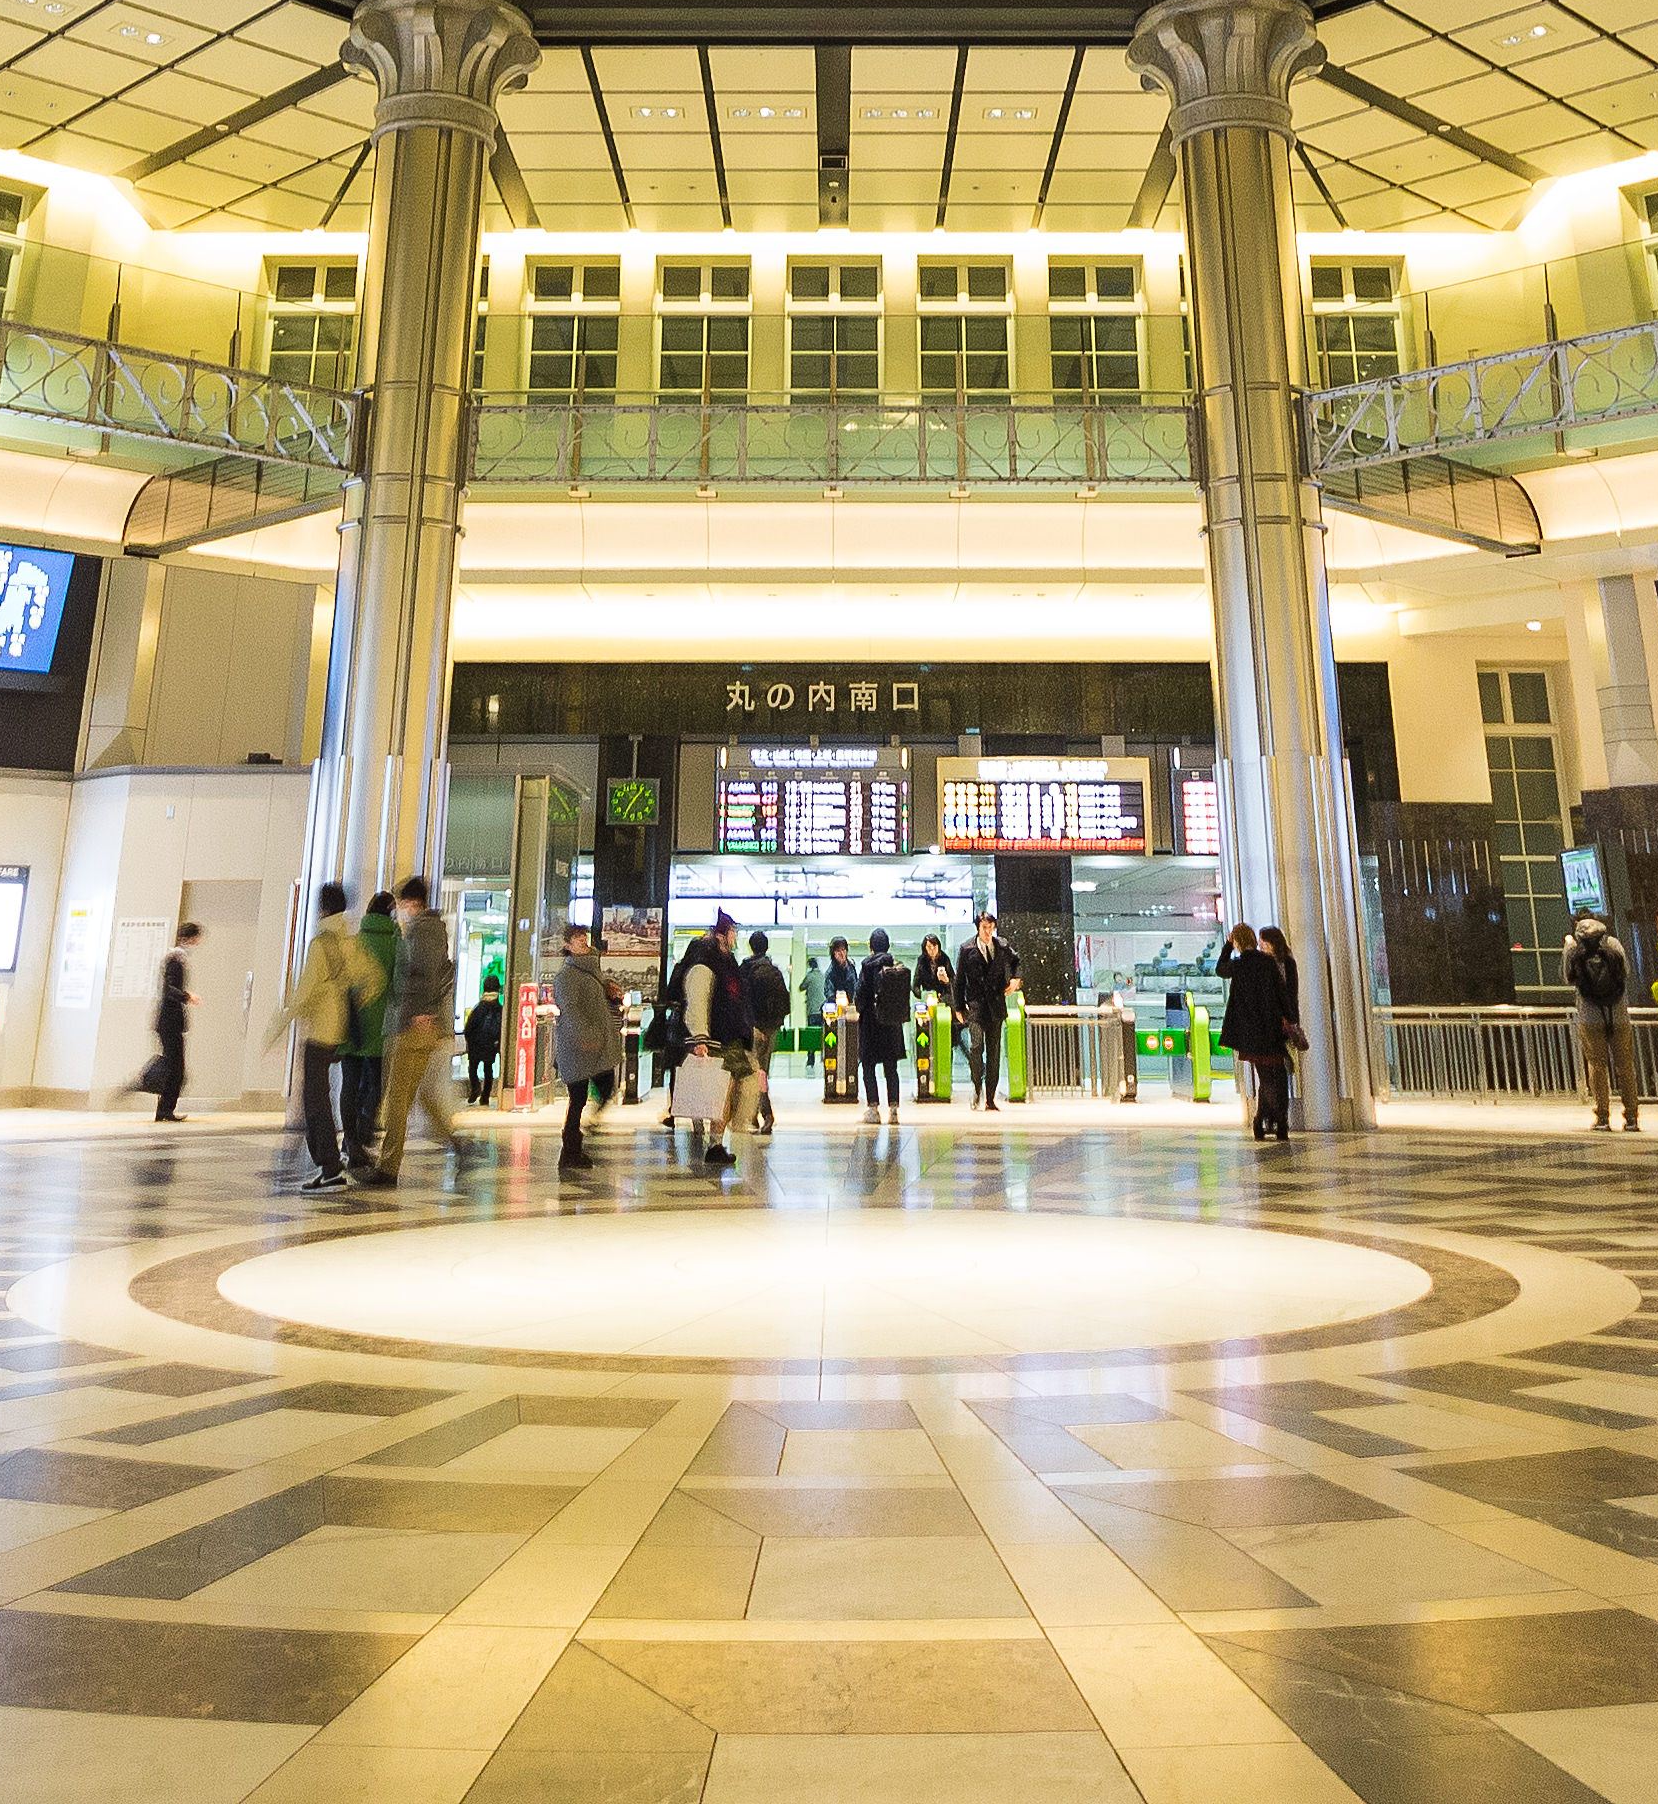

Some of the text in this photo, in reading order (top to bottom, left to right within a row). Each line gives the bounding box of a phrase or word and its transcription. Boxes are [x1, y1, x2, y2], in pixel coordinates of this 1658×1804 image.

[726, 680, 919, 712] 丸の内南口
